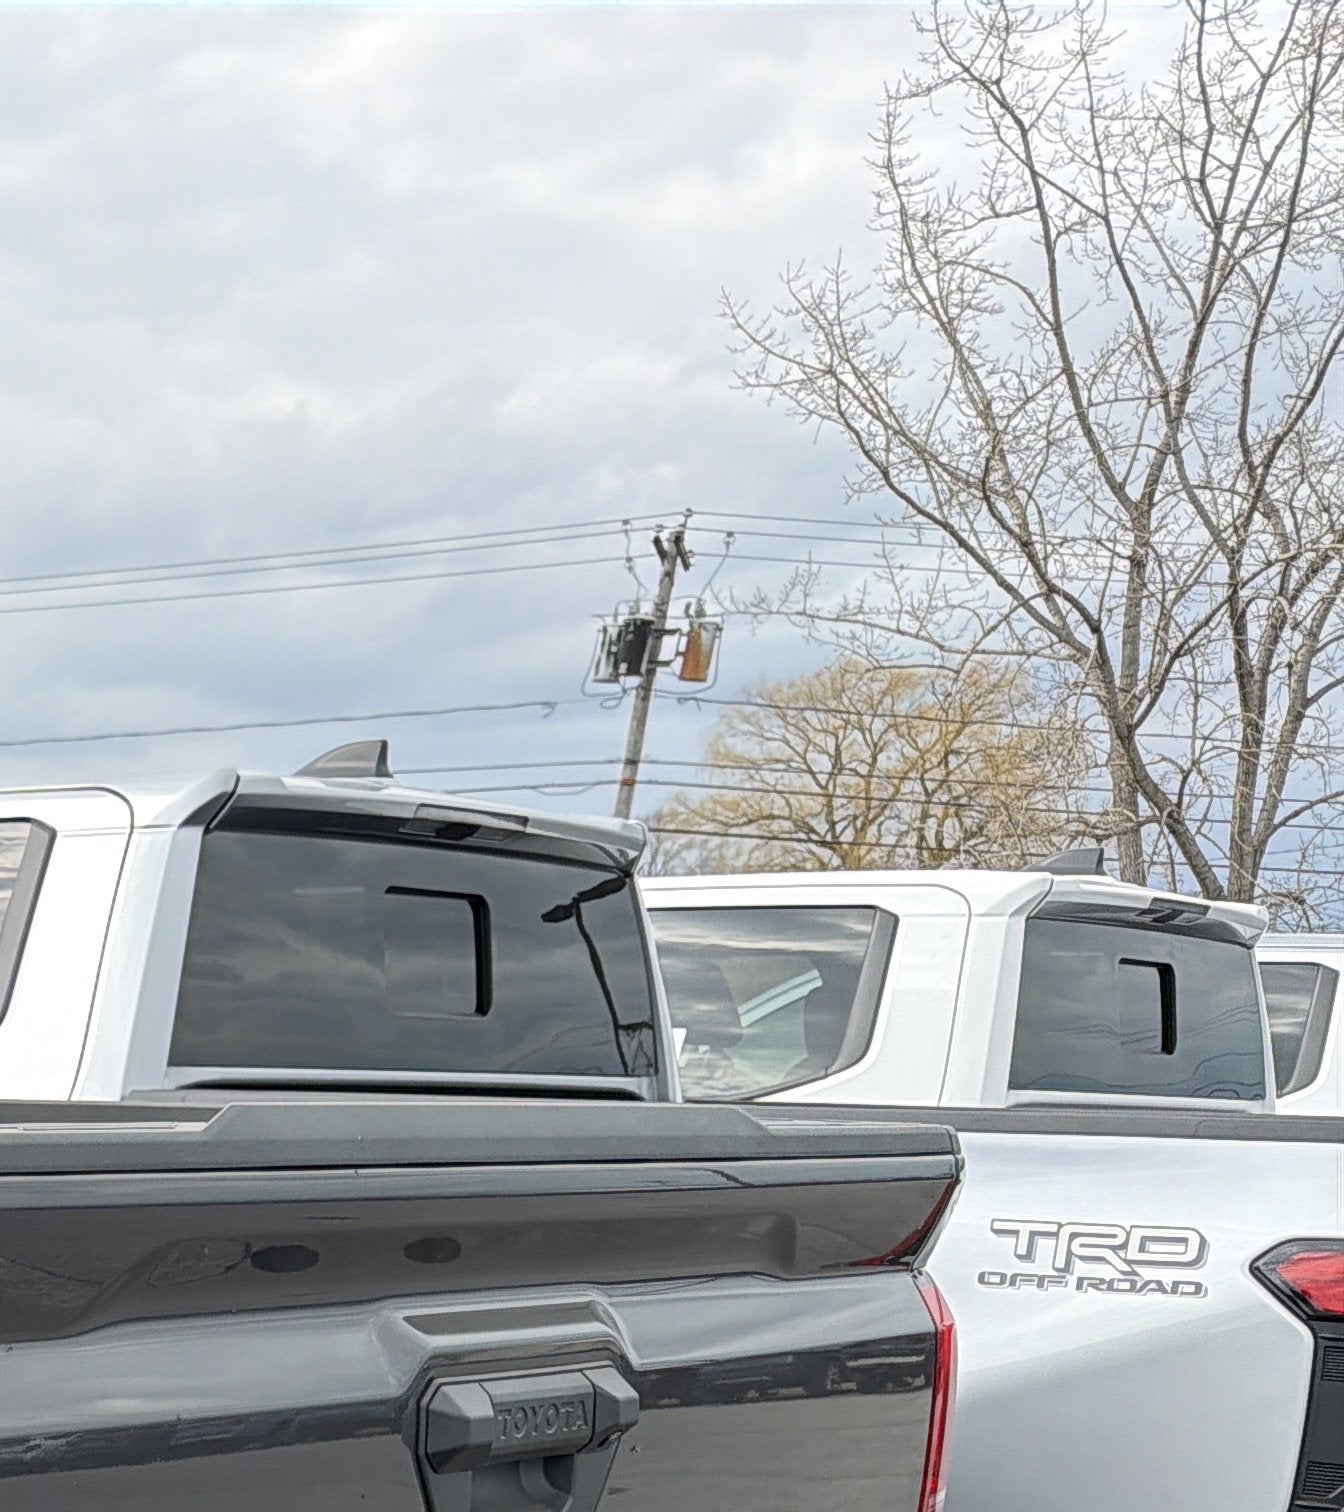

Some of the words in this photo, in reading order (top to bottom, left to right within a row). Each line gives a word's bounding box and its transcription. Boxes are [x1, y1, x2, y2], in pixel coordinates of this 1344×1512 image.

[990, 1218, 1210, 1280] TRD
[977, 1271, 1069, 1293] OFF
[1075, 1276, 1208, 1299] ROAD
[497, 1400, 588, 1440] TOYOTA
